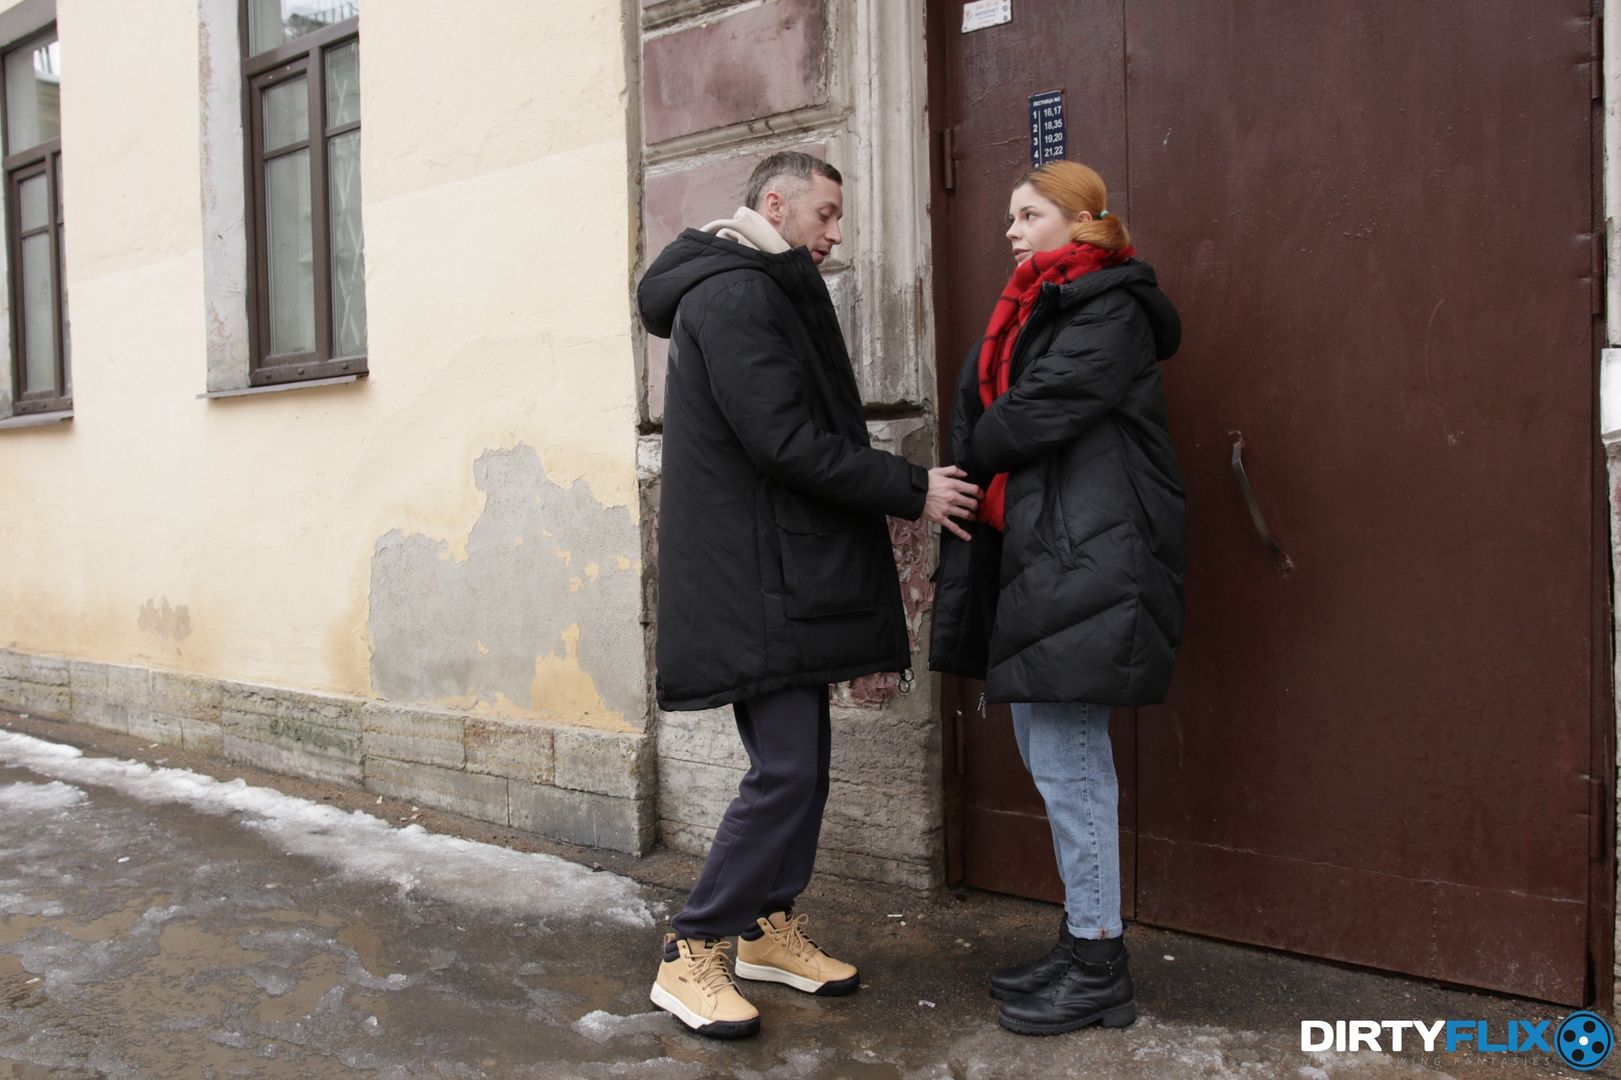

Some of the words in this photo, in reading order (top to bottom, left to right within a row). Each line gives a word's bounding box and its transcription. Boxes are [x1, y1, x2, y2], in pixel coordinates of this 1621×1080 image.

[1032, 110, 1037, 119] 1
[1043, 105, 1062, 117] 16,17
[1032, 124, 1038, 133] 2
[1044, 118, 1063, 130] 18,35
[1033, 136, 1038, 146] 3
[1044, 132, 1063, 143] 19,20
[1033, 149, 1039, 159] 4
[1044, 145, 1064, 157] 21,22
